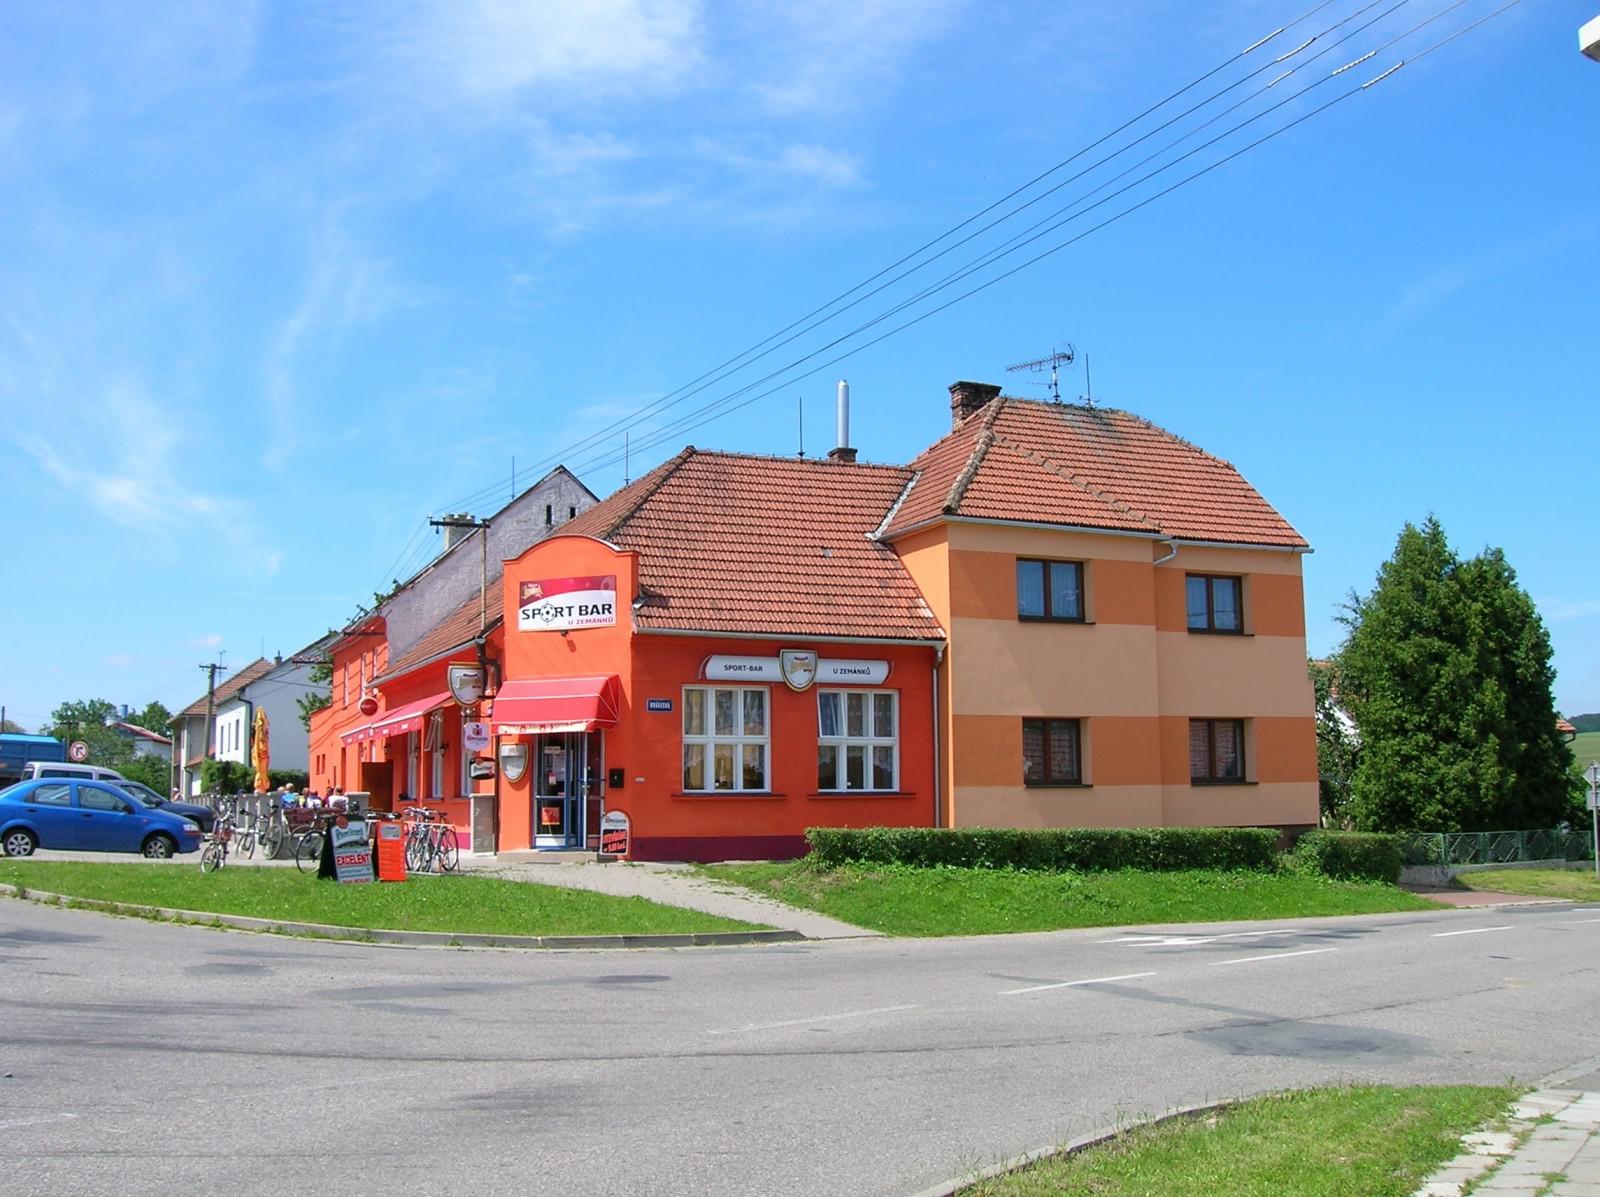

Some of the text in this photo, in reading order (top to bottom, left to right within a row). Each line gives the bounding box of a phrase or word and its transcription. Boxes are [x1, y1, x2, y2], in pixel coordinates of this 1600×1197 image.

[522, 603, 612, 622] SPORT BAR
[723, 664, 763, 672] SPORT-BAR
[336, 854, 369, 865] EXCELENT
